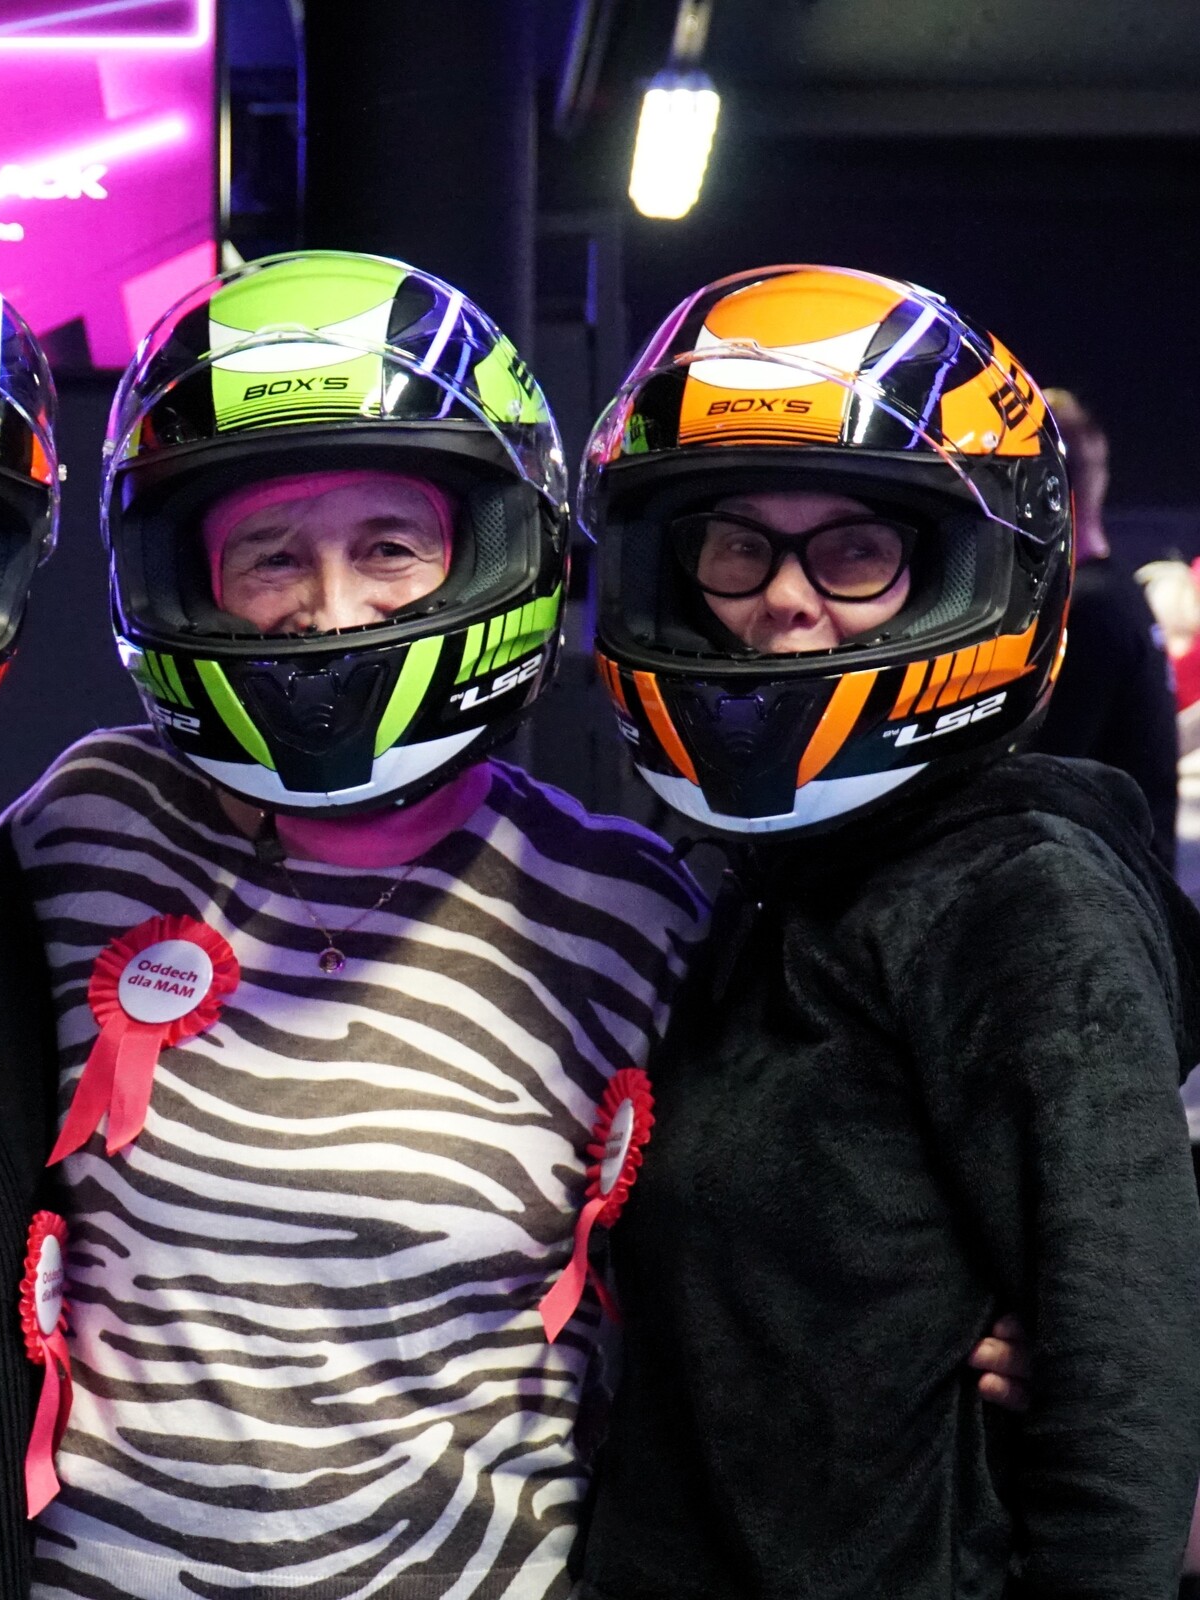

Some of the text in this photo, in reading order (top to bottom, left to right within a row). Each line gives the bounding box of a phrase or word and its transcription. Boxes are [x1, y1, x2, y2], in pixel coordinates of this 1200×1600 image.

[243, 377, 349, 401] BOX'S
[706, 398, 812, 416] BOX'S
[460, 653, 542, 711] LS2
[154, 704, 201, 735] S2
[894, 691, 1007, 747] LS2
[138, 960, 198, 983] Oddech
[128, 975, 195, 998] dla MAM
